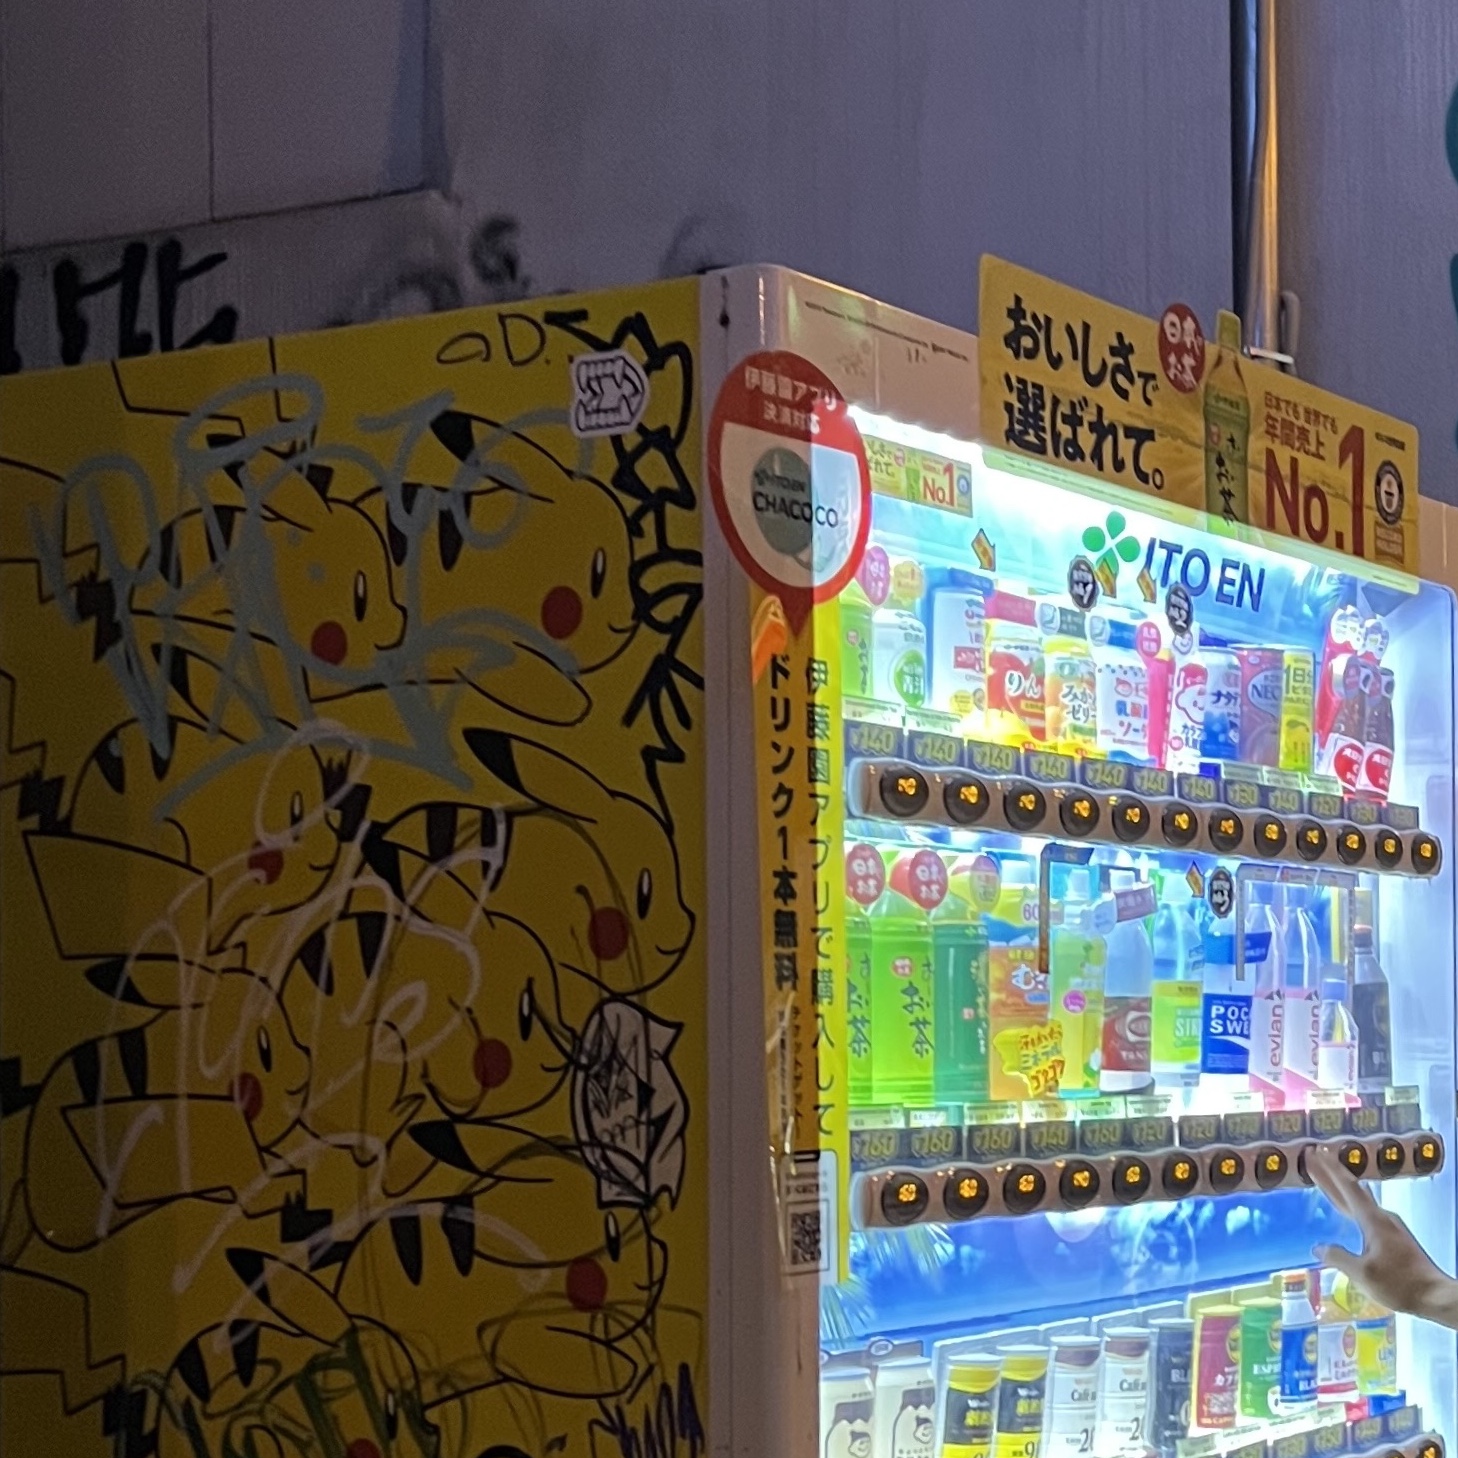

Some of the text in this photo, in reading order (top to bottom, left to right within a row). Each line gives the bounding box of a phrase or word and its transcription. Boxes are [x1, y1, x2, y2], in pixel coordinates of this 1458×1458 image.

[1003, 293, 1160, 407] おいしさで
[1003, 372, 1165, 490] 選ばれて。
[752, 491, 839, 528] CHACOCO
[1144, 537, 1266, 612] ITO EN
[1268, 1003, 1283, 1068] evian
